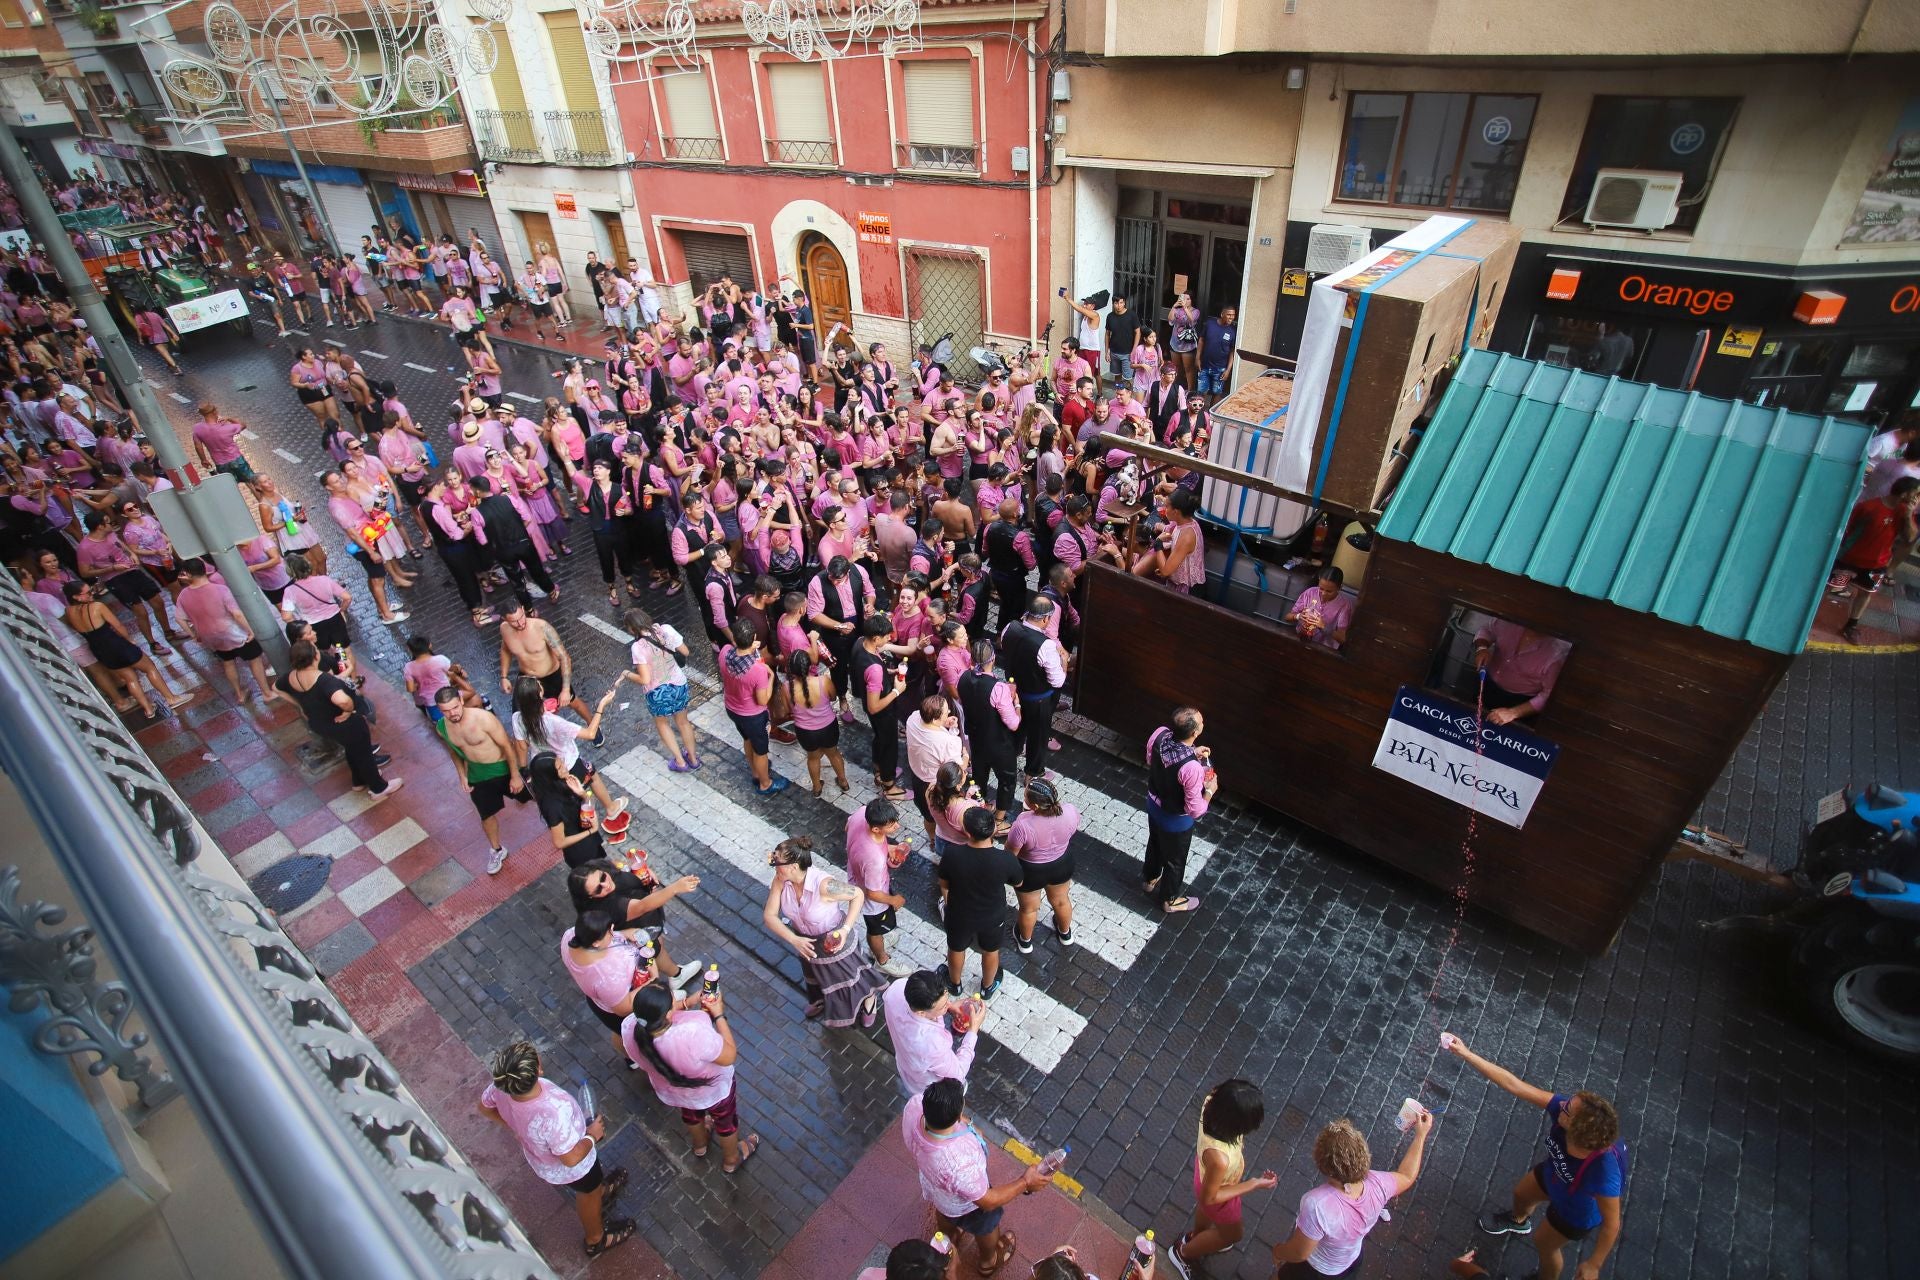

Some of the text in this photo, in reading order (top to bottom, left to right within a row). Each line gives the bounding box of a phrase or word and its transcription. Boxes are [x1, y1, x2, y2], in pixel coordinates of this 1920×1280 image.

[859, 211, 889, 223] Hypnos
[860, 224, 890, 234] VENDE
[1547, 291, 1570, 299] orange
[1619, 276, 1734, 315] Orange
[1811, 315, 1834, 324] orange
[1401, 697, 1550, 762] GARCIA CARRION
[1438, 727, 1463, 740] DESDE
